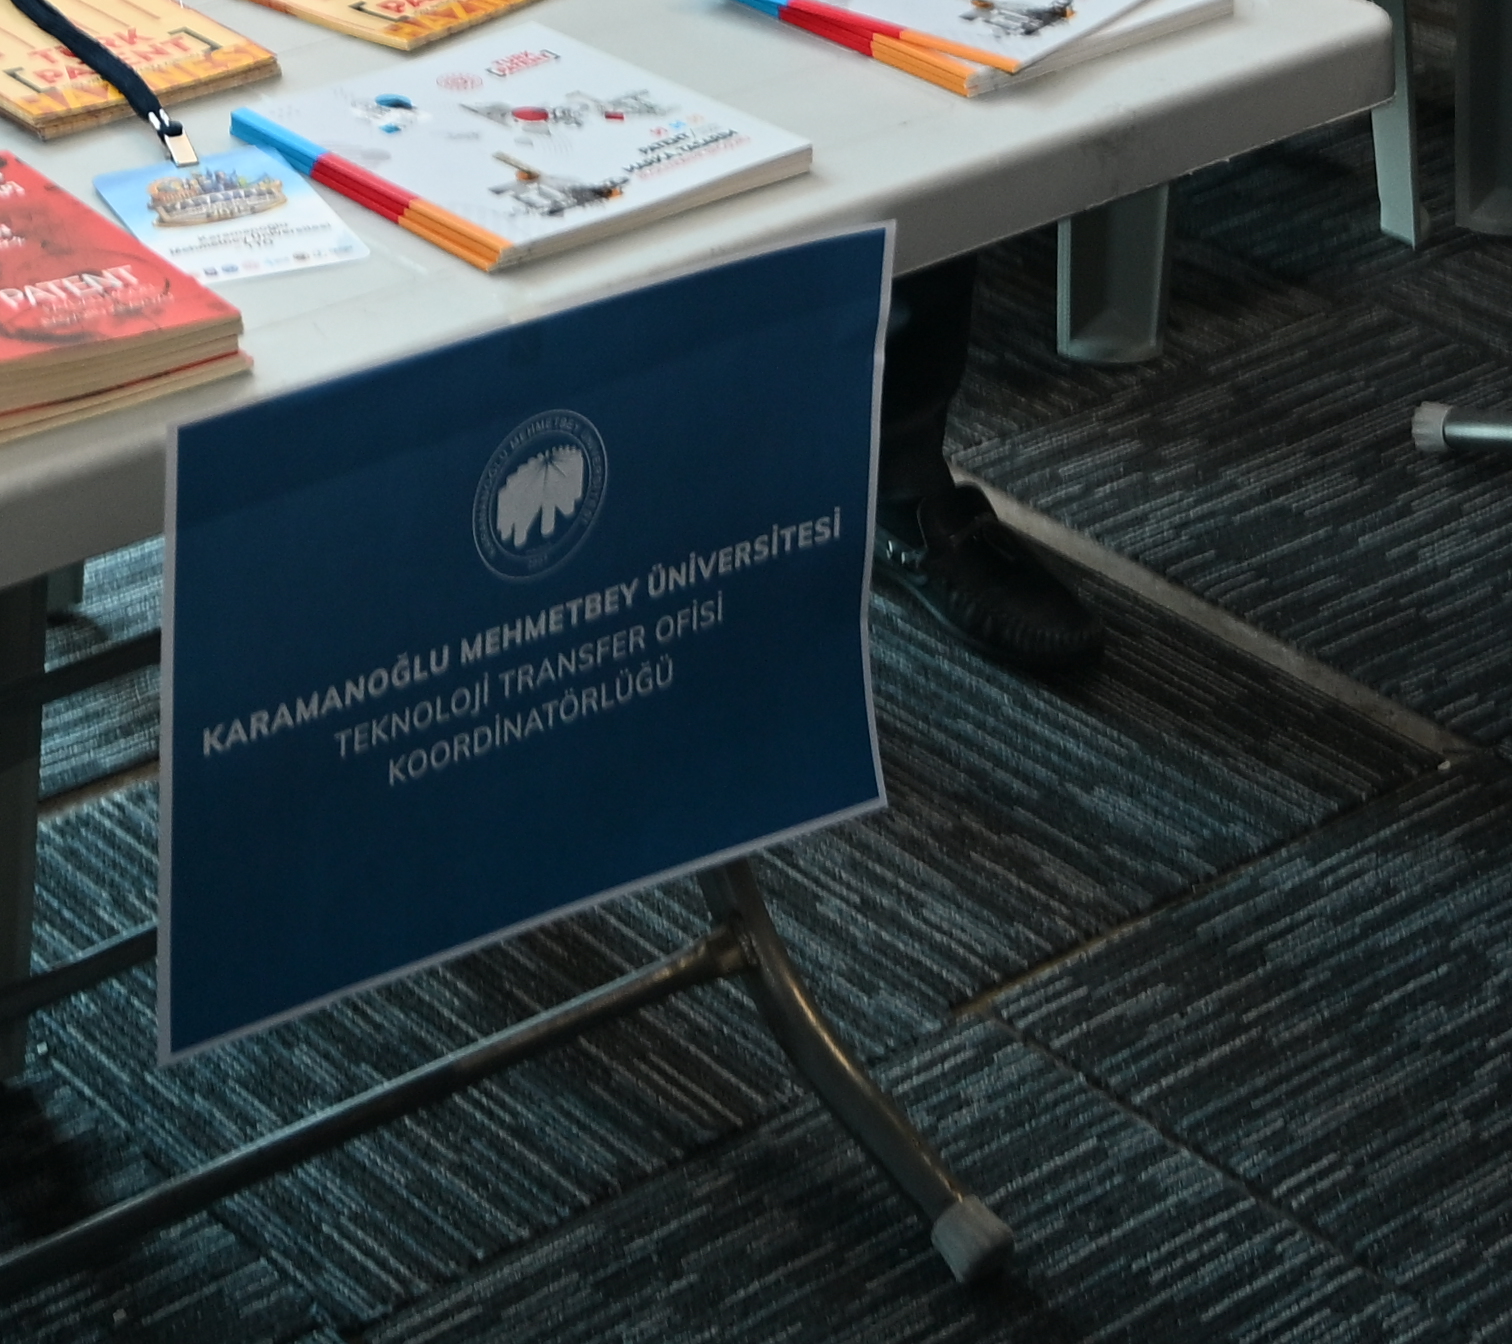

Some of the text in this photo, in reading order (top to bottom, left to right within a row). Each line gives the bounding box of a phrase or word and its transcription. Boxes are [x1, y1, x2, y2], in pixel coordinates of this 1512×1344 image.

[33, 35, 199, 85] PAENT
[202, 507, 842, 758] KARAMANOĞLU MEHMETBEY ÜNİVERSİTESİ
[334, 590, 725, 760] TEKNOLOJİ TRANSFER OFİSİ
[387, 656, 676, 787] KOORDİNATÖRLÜĞÜ
